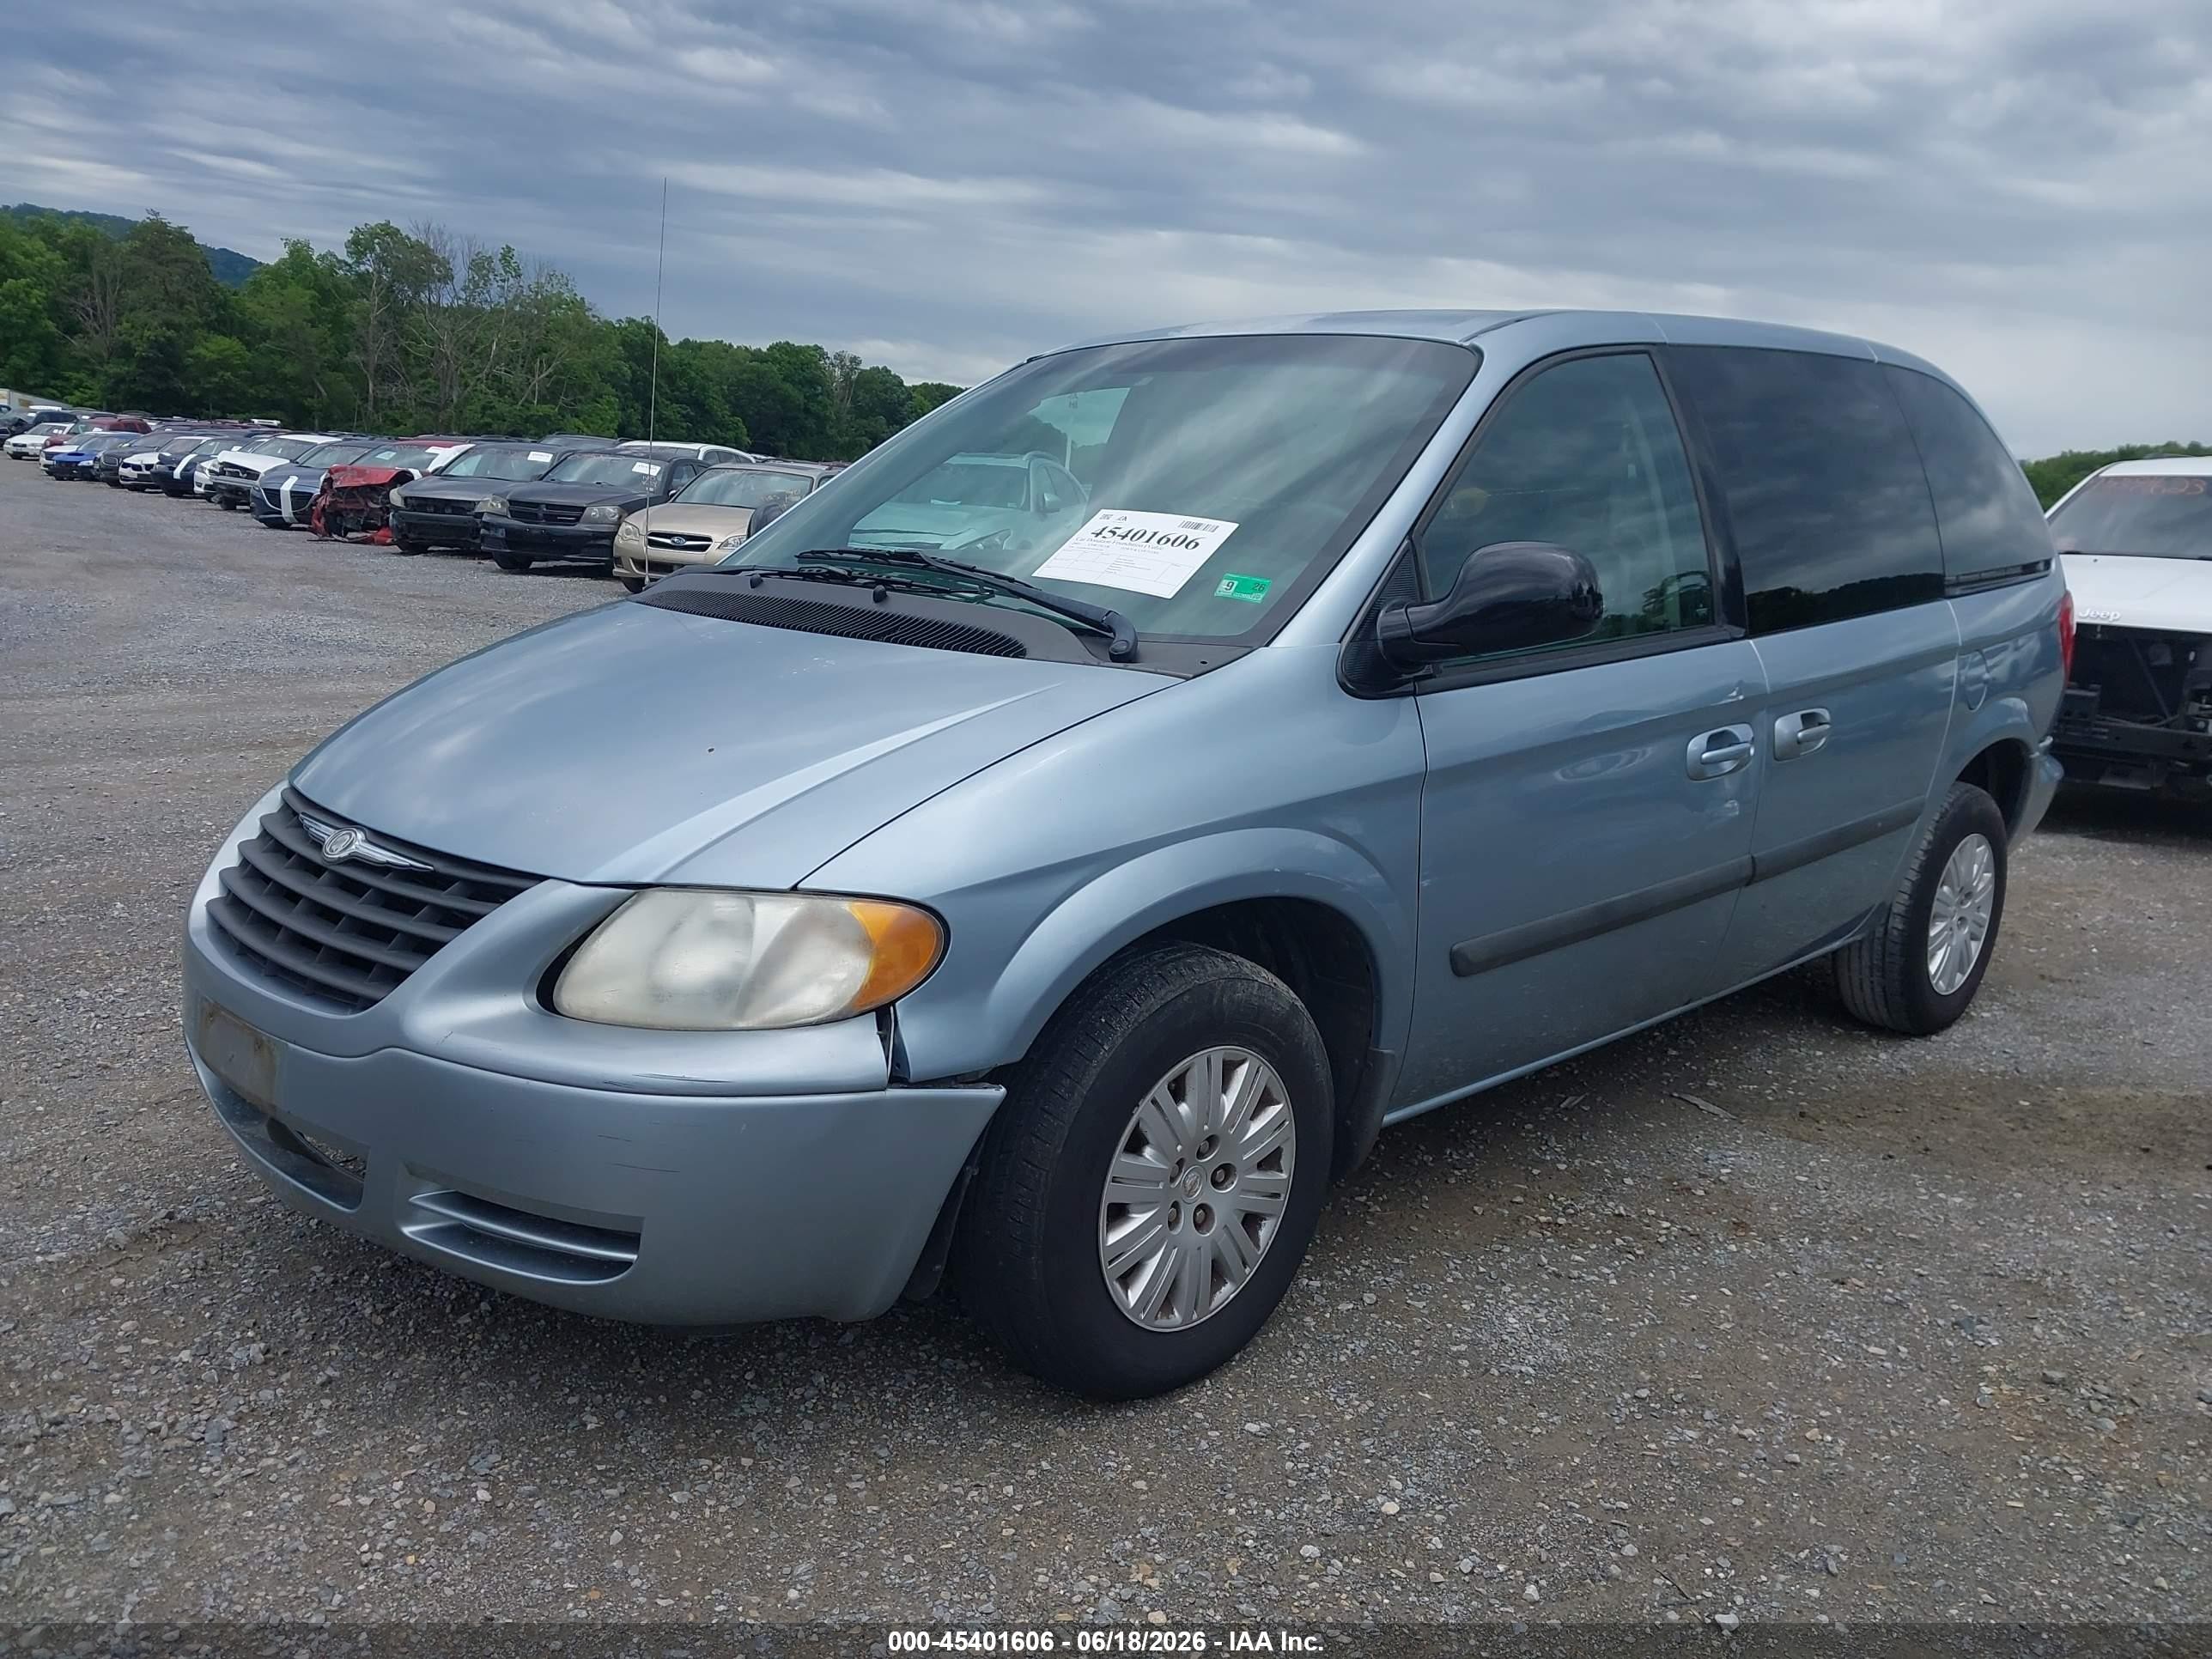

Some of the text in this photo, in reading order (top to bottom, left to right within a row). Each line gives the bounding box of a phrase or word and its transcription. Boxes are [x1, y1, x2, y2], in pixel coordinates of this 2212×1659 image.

[1091, 526, 1205, 550] 45401606
[1224, 581, 1235, 591] 9
[2078, 608, 2121, 622] Jeep
